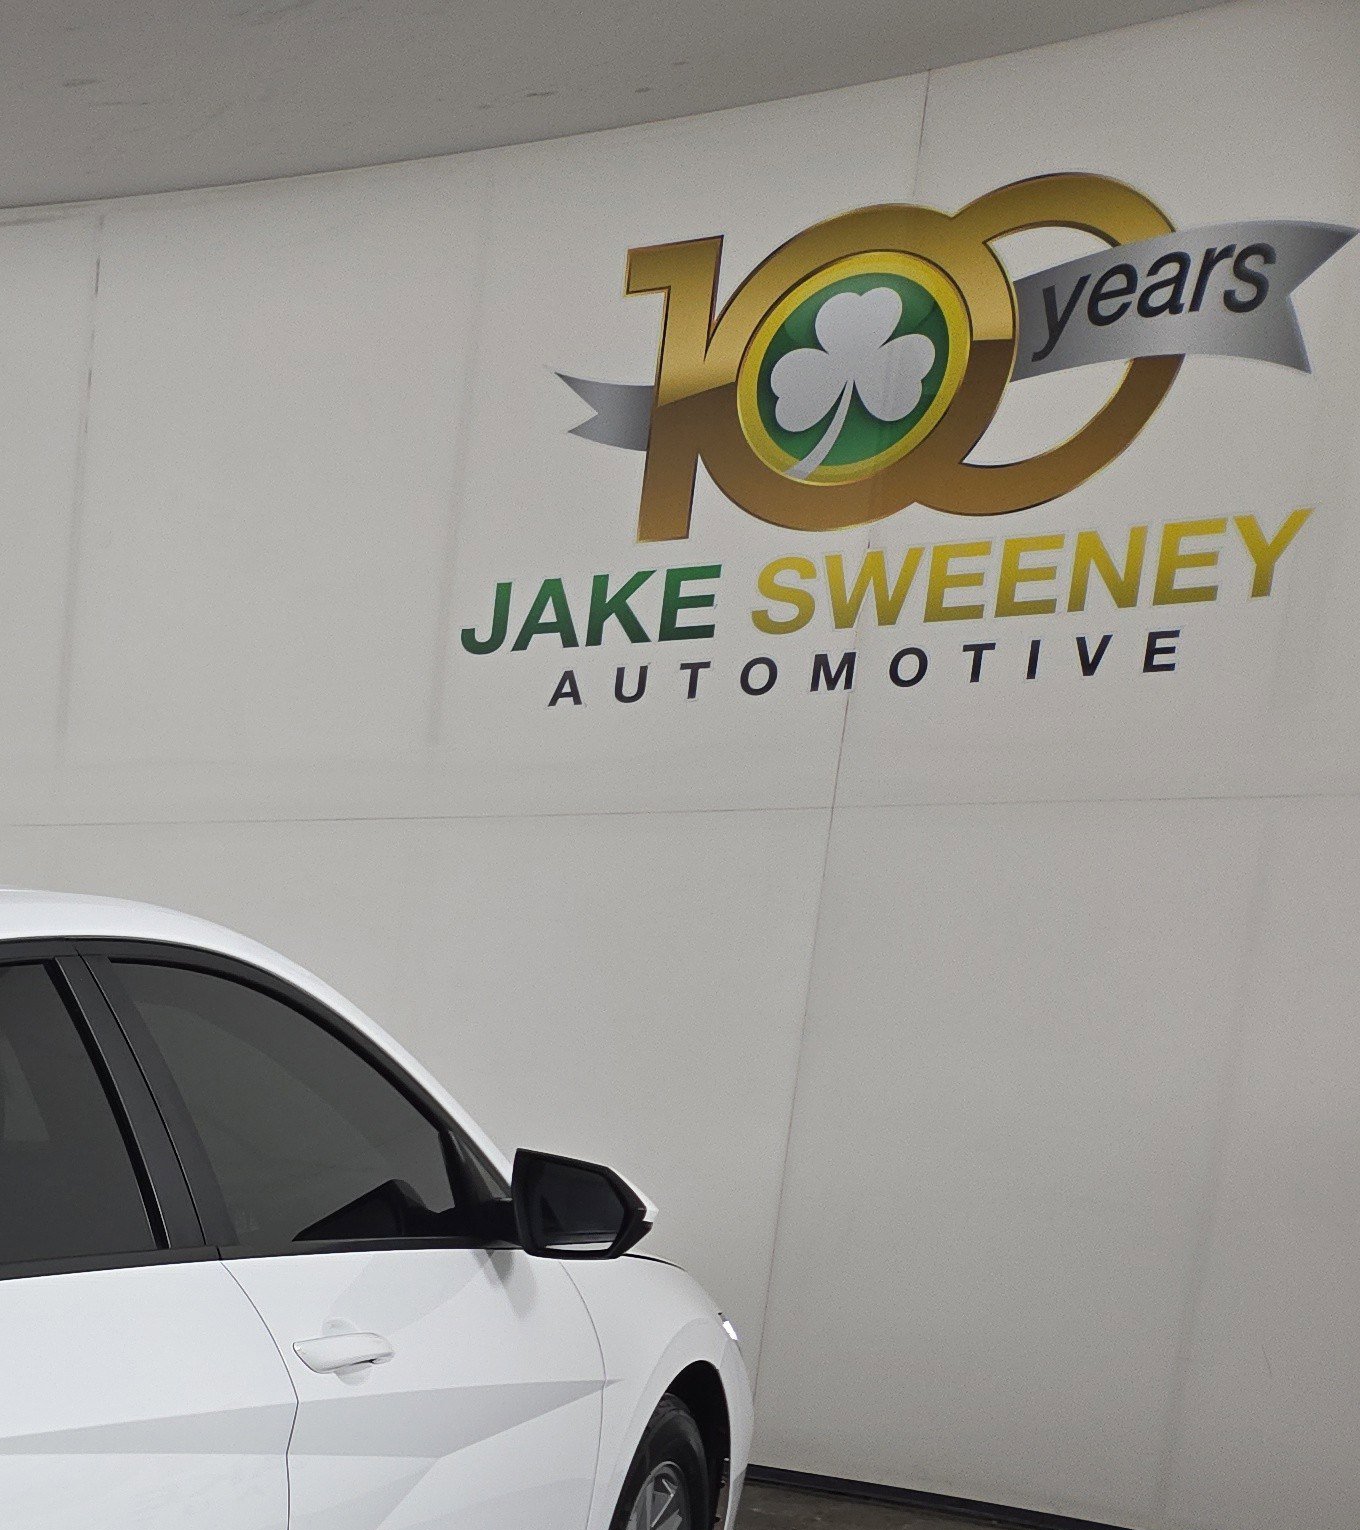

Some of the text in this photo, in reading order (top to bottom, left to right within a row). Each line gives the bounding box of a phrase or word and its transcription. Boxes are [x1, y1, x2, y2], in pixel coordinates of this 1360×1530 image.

[1032, 239, 1278, 362] years
[460, 508, 1314, 658] JAKE SWEENEY
[548, 629, 1184, 708] AUTOMOTIVE
